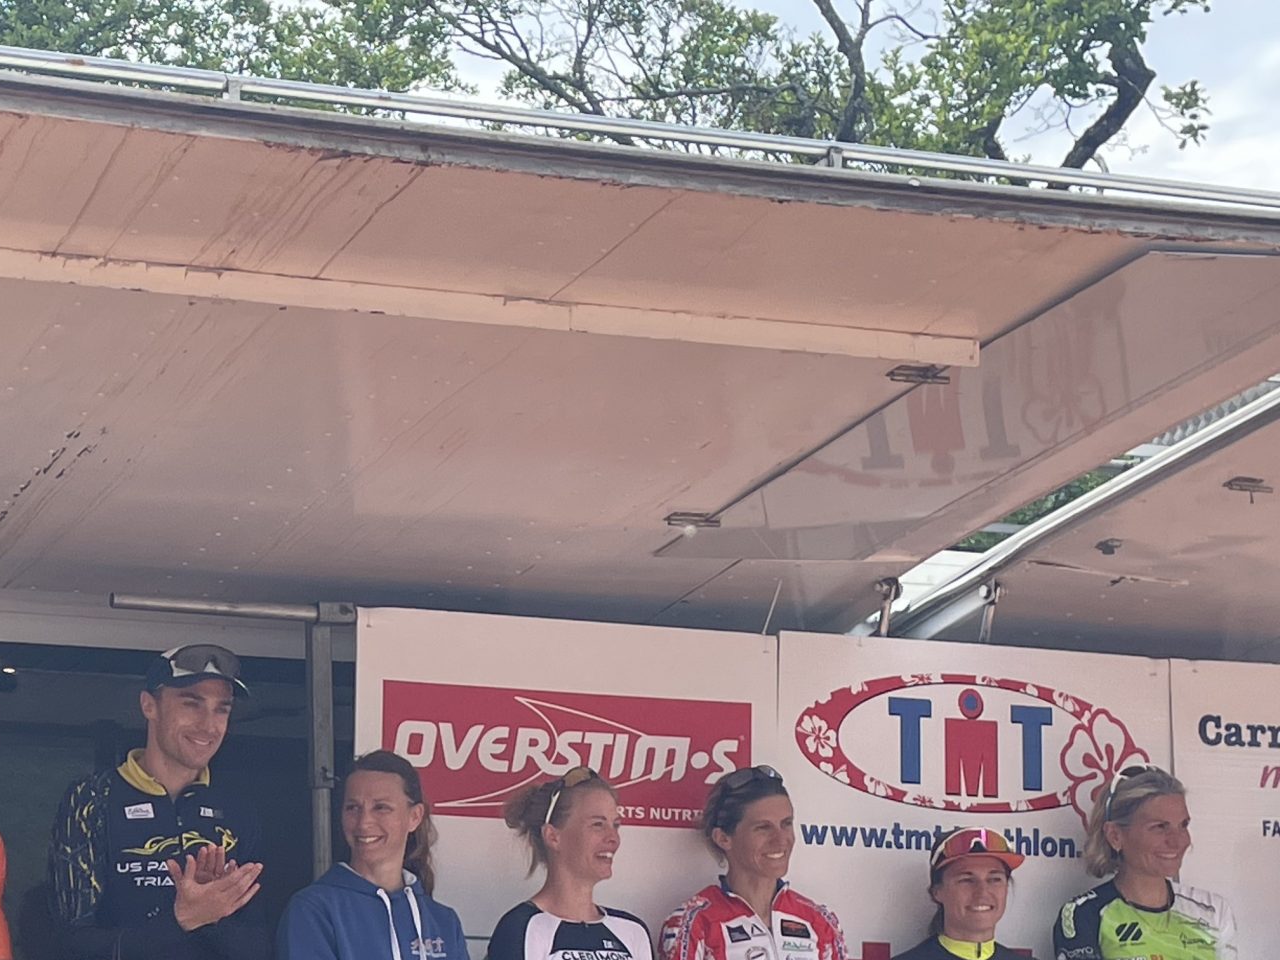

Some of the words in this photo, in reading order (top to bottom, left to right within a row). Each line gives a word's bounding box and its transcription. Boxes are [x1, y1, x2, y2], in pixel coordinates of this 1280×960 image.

[888, 688, 1053, 798] TMT
[117, 862, 143, 873] US
[147, 861, 169, 872] PA
[133, 876, 176, 887] TRIA
